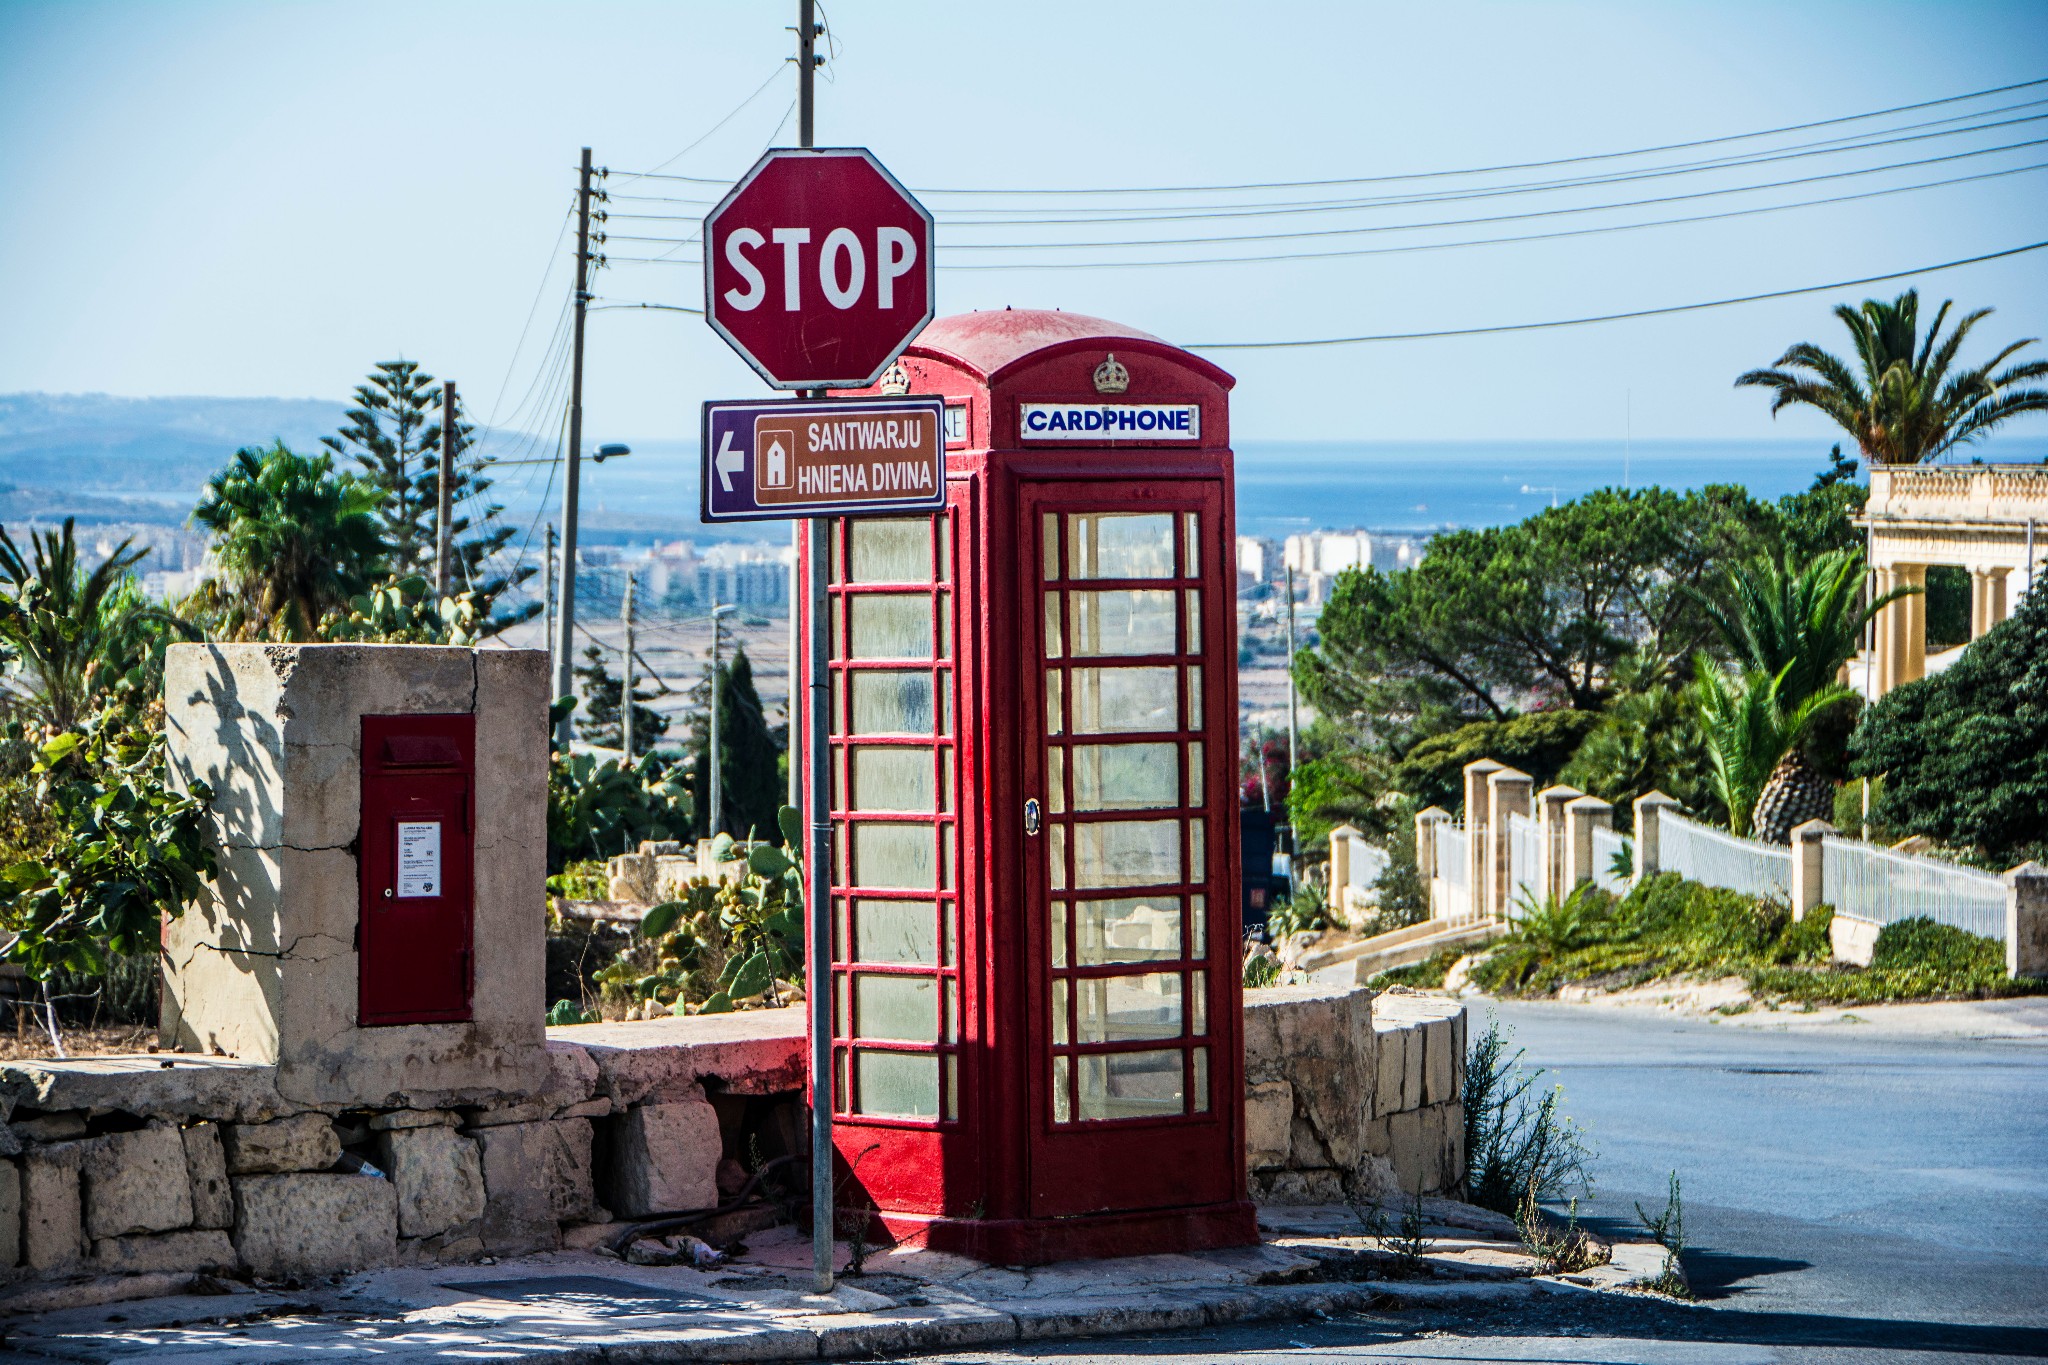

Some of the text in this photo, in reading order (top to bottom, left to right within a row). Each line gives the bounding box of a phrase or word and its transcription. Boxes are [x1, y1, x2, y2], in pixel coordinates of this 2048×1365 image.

[724, 226, 917, 312] STOP
[808, 420, 921, 452] SANTWARJU
[1026, 410, 1190, 432] CARDPHONE
[798, 461, 932, 494] HNIENA DIVINA
